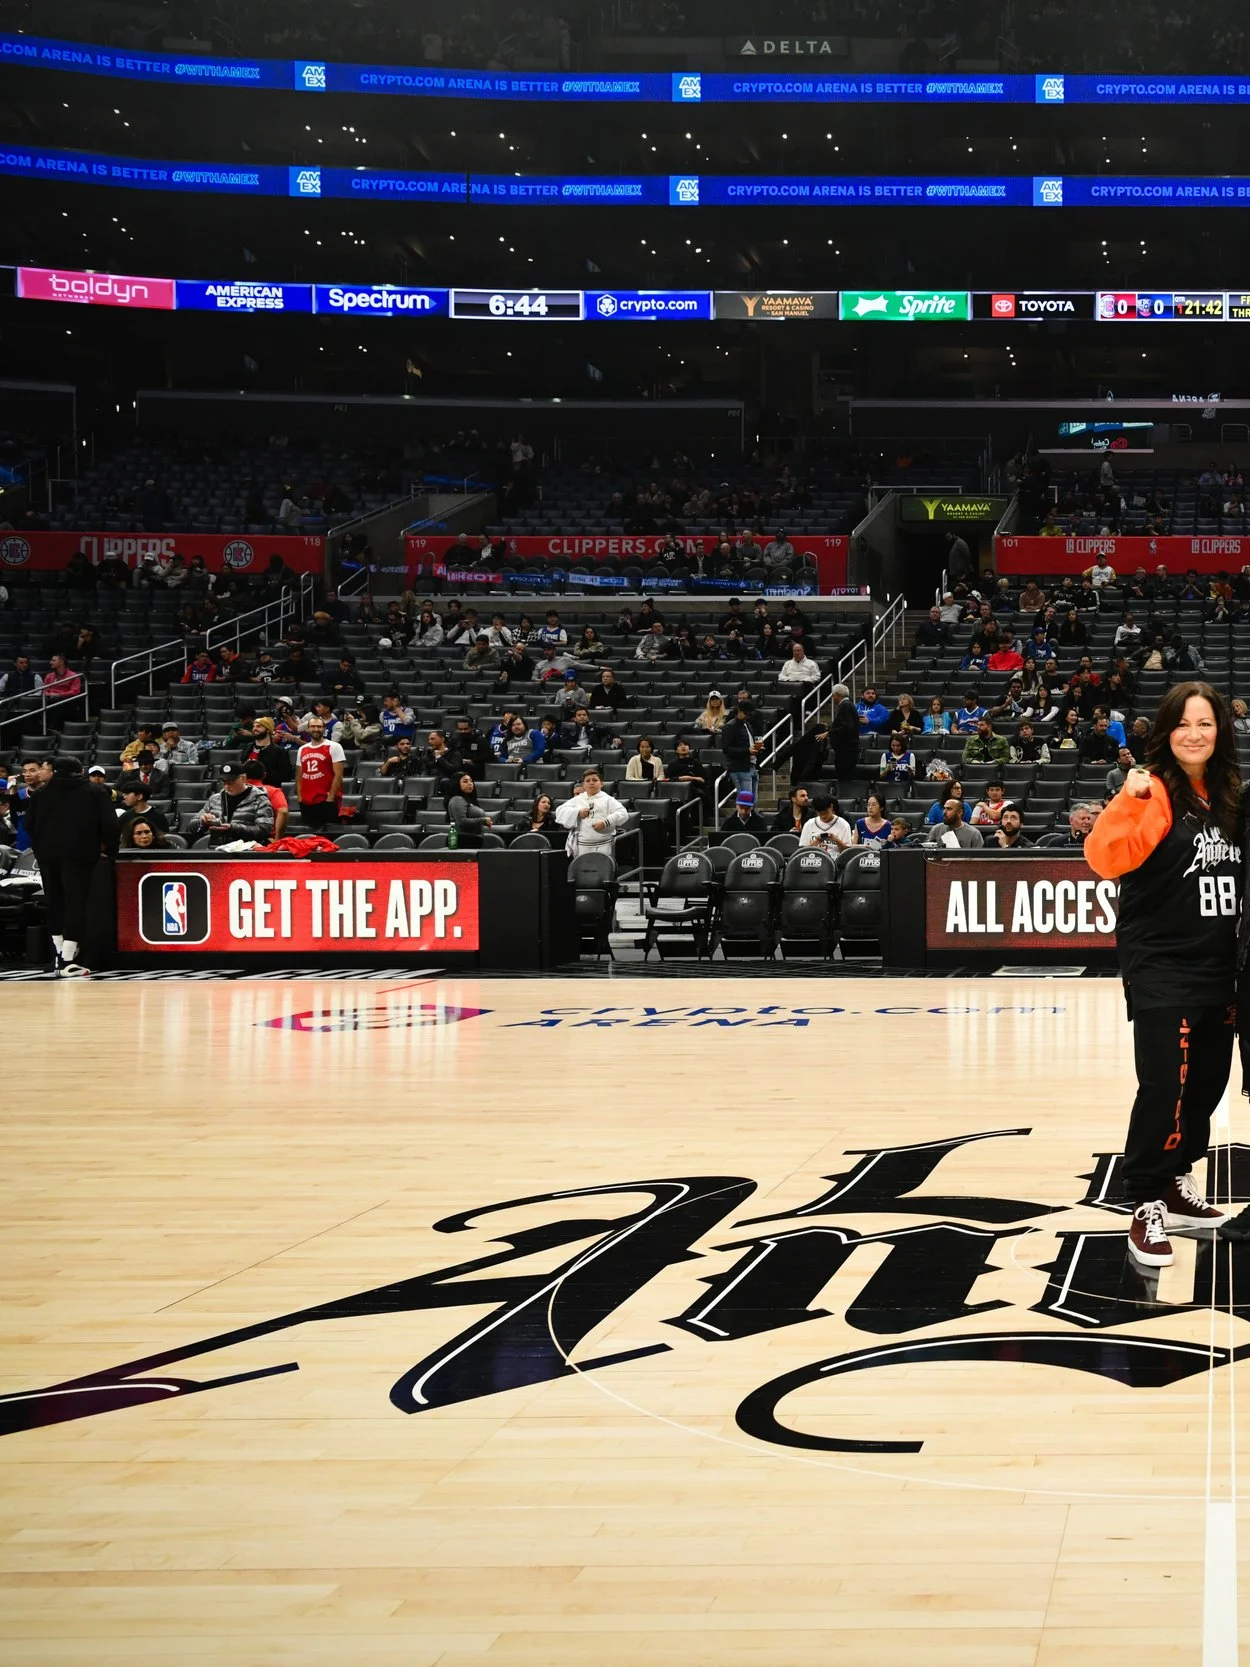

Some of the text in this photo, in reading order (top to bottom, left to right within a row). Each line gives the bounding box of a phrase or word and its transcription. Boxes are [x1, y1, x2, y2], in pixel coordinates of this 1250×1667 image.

[763, 41, 833, 54] DELTA
[43, 49, 92, 64] ARENA
[98, 56, 111, 66] IS
[116, 58, 170, 73] BETTER
[175, 64, 260, 79] #WITHAMEX
[303, 67, 325, 78] AM
[306, 76, 325, 86] EX
[361, 74, 640, 92] CRYPTO.COM ARENA IS BETTER #WITHAMEX
[679, 78, 700, 88] AM
[1042, 79, 1064, 90] AM
[682, 88, 700, 97] EX
[734, 83, 1003, 94] CRYPTO.COM ARENA IS BETTER #WITHAMEX
[1045, 88, 1064, 98] EX
[1097, 84, 1175, 94] CRYPTO.COM
[1179, 85, 1220, 94] ARENA
[1223, 85, 1235, 94] IS
[728, 185, 1006, 196] CRYPTO.COM ARENA IS BETTER #WITHAMEX
[1091, 186, 1172, 196] CRYPTO.COM
[1176, 187, 1219, 196] ARENA
[1222, 187, 1234, 197] IS
[49, 274, 148, 303] boldyn
[205, 285, 283, 298] AMERICAN
[217, 296, 284, 309] EXPRESS
[328, 289, 430, 311] Spectrum
[620, 298, 698, 312] crypto.com
[489, 296, 548, 316] 6:44
[899, 295, 956, 317] Sprite
[1019, 301, 1075, 312] TOYOTA
[1117, 300, 1128, 314] 0
[1153, 300, 1164, 314] 0
[1185, 300, 1222, 315] 21:42
[304, 538, 321, 546] 118
[410, 540, 426, 548] 119
[824, 539, 841, 547] 119
[1002, 539, 1018, 547] 101
[1076, 539, 1115, 554] CLIPPERS
[1202, 539, 1241, 554] CLIPPERS
[80, 536, 176, 567] CLIPPERS
[307, 760, 318, 772] 12
[895, 772, 901, 780] 2
[1183, 833, 1242, 877] Angele
[678, 858, 699, 868] CLIPPERS
[742, 858, 763, 868] CLIPPERS
[800, 857, 821, 867] CLIPPERS
[1198, 876, 1236, 917] 88
[229, 879, 462, 938] GET THE APP.
[945, 880, 1121, 933] ALL ACCES
[540, 1006, 1065, 1016] crypto.com
[500, 1018, 810, 1028] ARENA
